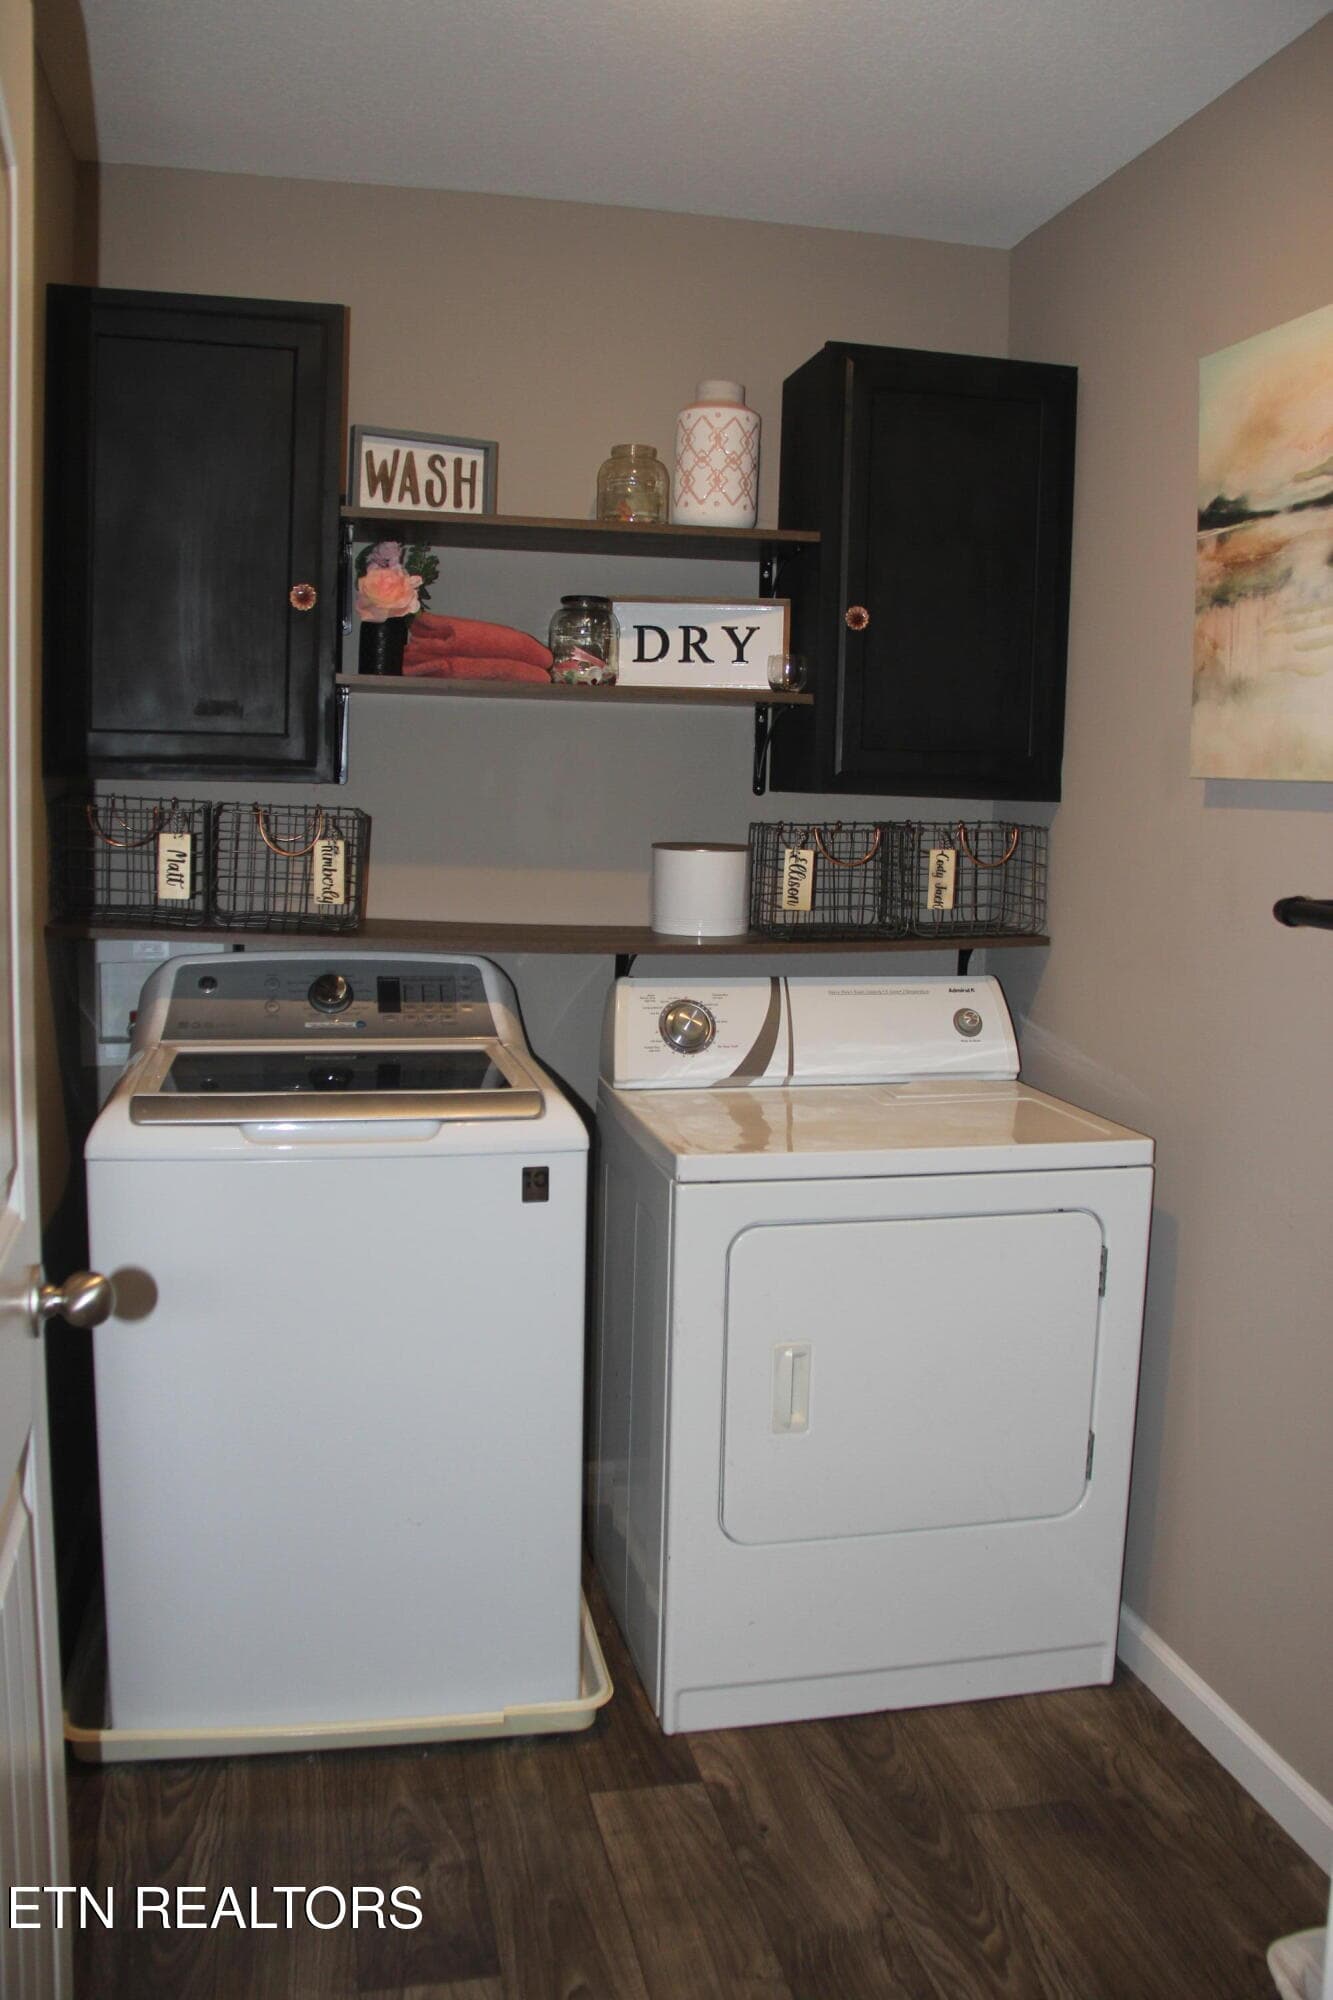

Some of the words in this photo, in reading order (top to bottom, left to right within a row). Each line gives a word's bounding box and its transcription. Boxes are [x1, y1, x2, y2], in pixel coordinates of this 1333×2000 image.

[365, 448, 479, 509] WASH
[632, 624, 761, 665] DRY
[166, 849, 188, 890] Matt
